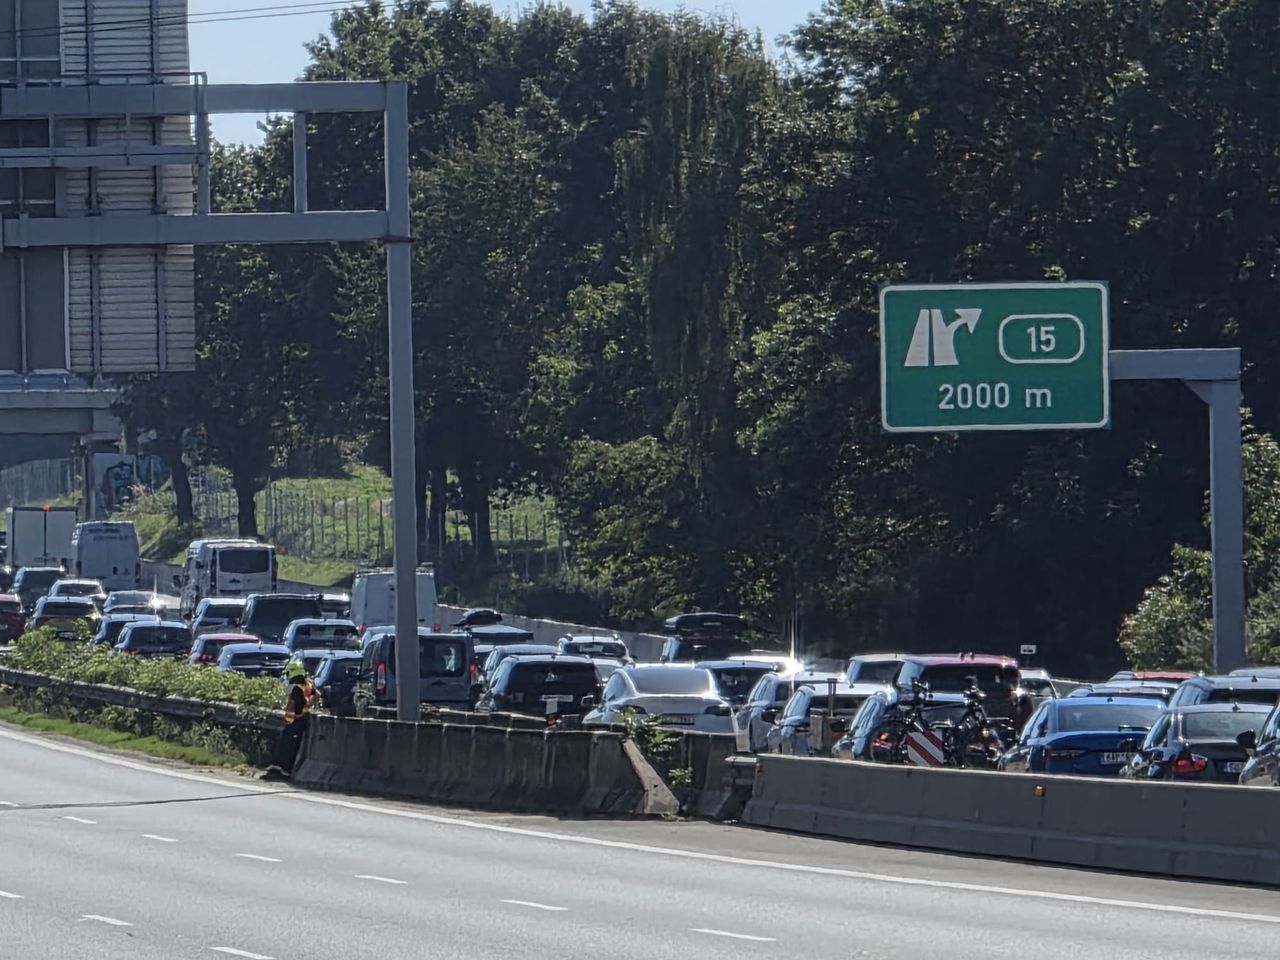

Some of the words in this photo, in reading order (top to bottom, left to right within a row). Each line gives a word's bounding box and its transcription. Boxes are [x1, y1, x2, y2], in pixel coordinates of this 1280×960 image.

[1027, 326, 1056, 352] 15
[938, 382, 1010, 410] 2000
[1025, 388, 1052, 408] m
